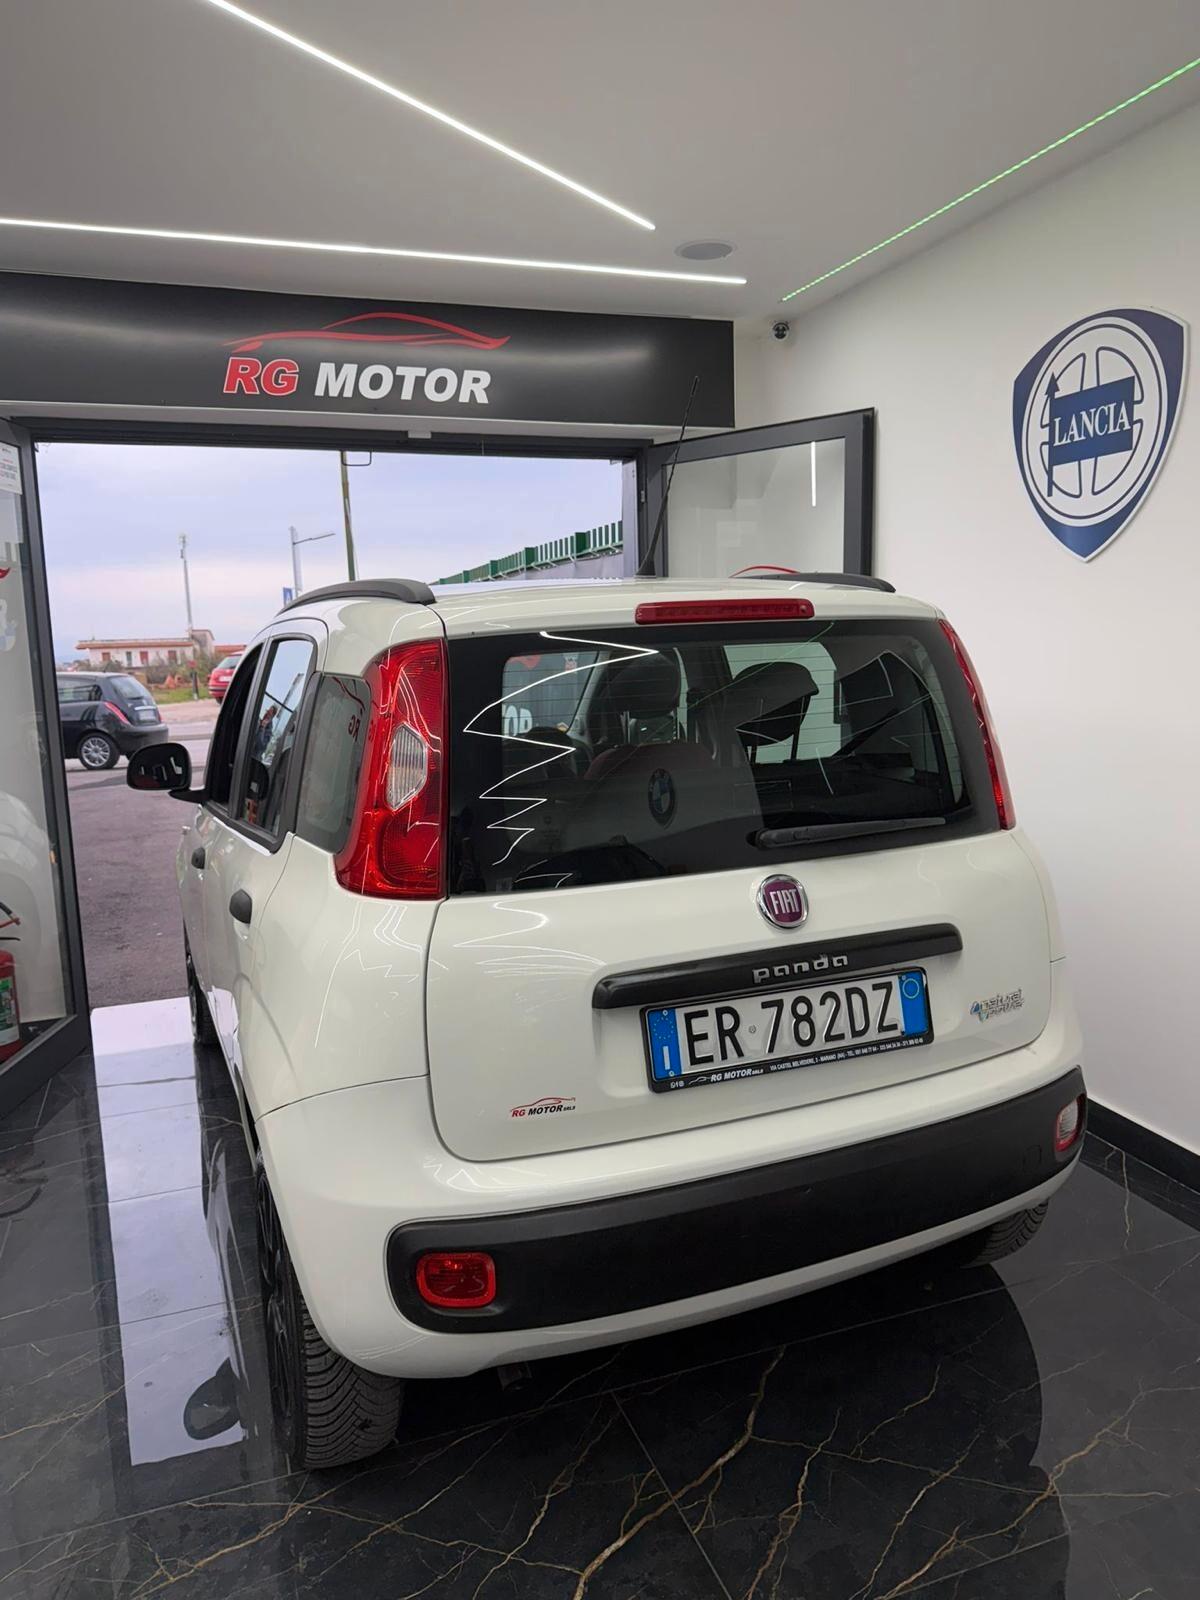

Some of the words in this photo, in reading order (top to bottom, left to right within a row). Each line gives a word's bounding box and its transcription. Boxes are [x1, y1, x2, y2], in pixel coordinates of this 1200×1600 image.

[223, 357, 299, 397] RG
[314, 362, 491, 404] MOTOR
[1053, 401, 1131, 447] LANCIA
[769, 889, 800, 915] FIAT
[752, 954, 848, 984] panda
[684, 1005, 744, 1066] ER
[760, 981, 899, 1054] 782DZ
[724, 1068, 752, 1080] MOTOR
[511, 1109, 526, 1117] RG
[528, 1104, 563, 1116] MOTOR
